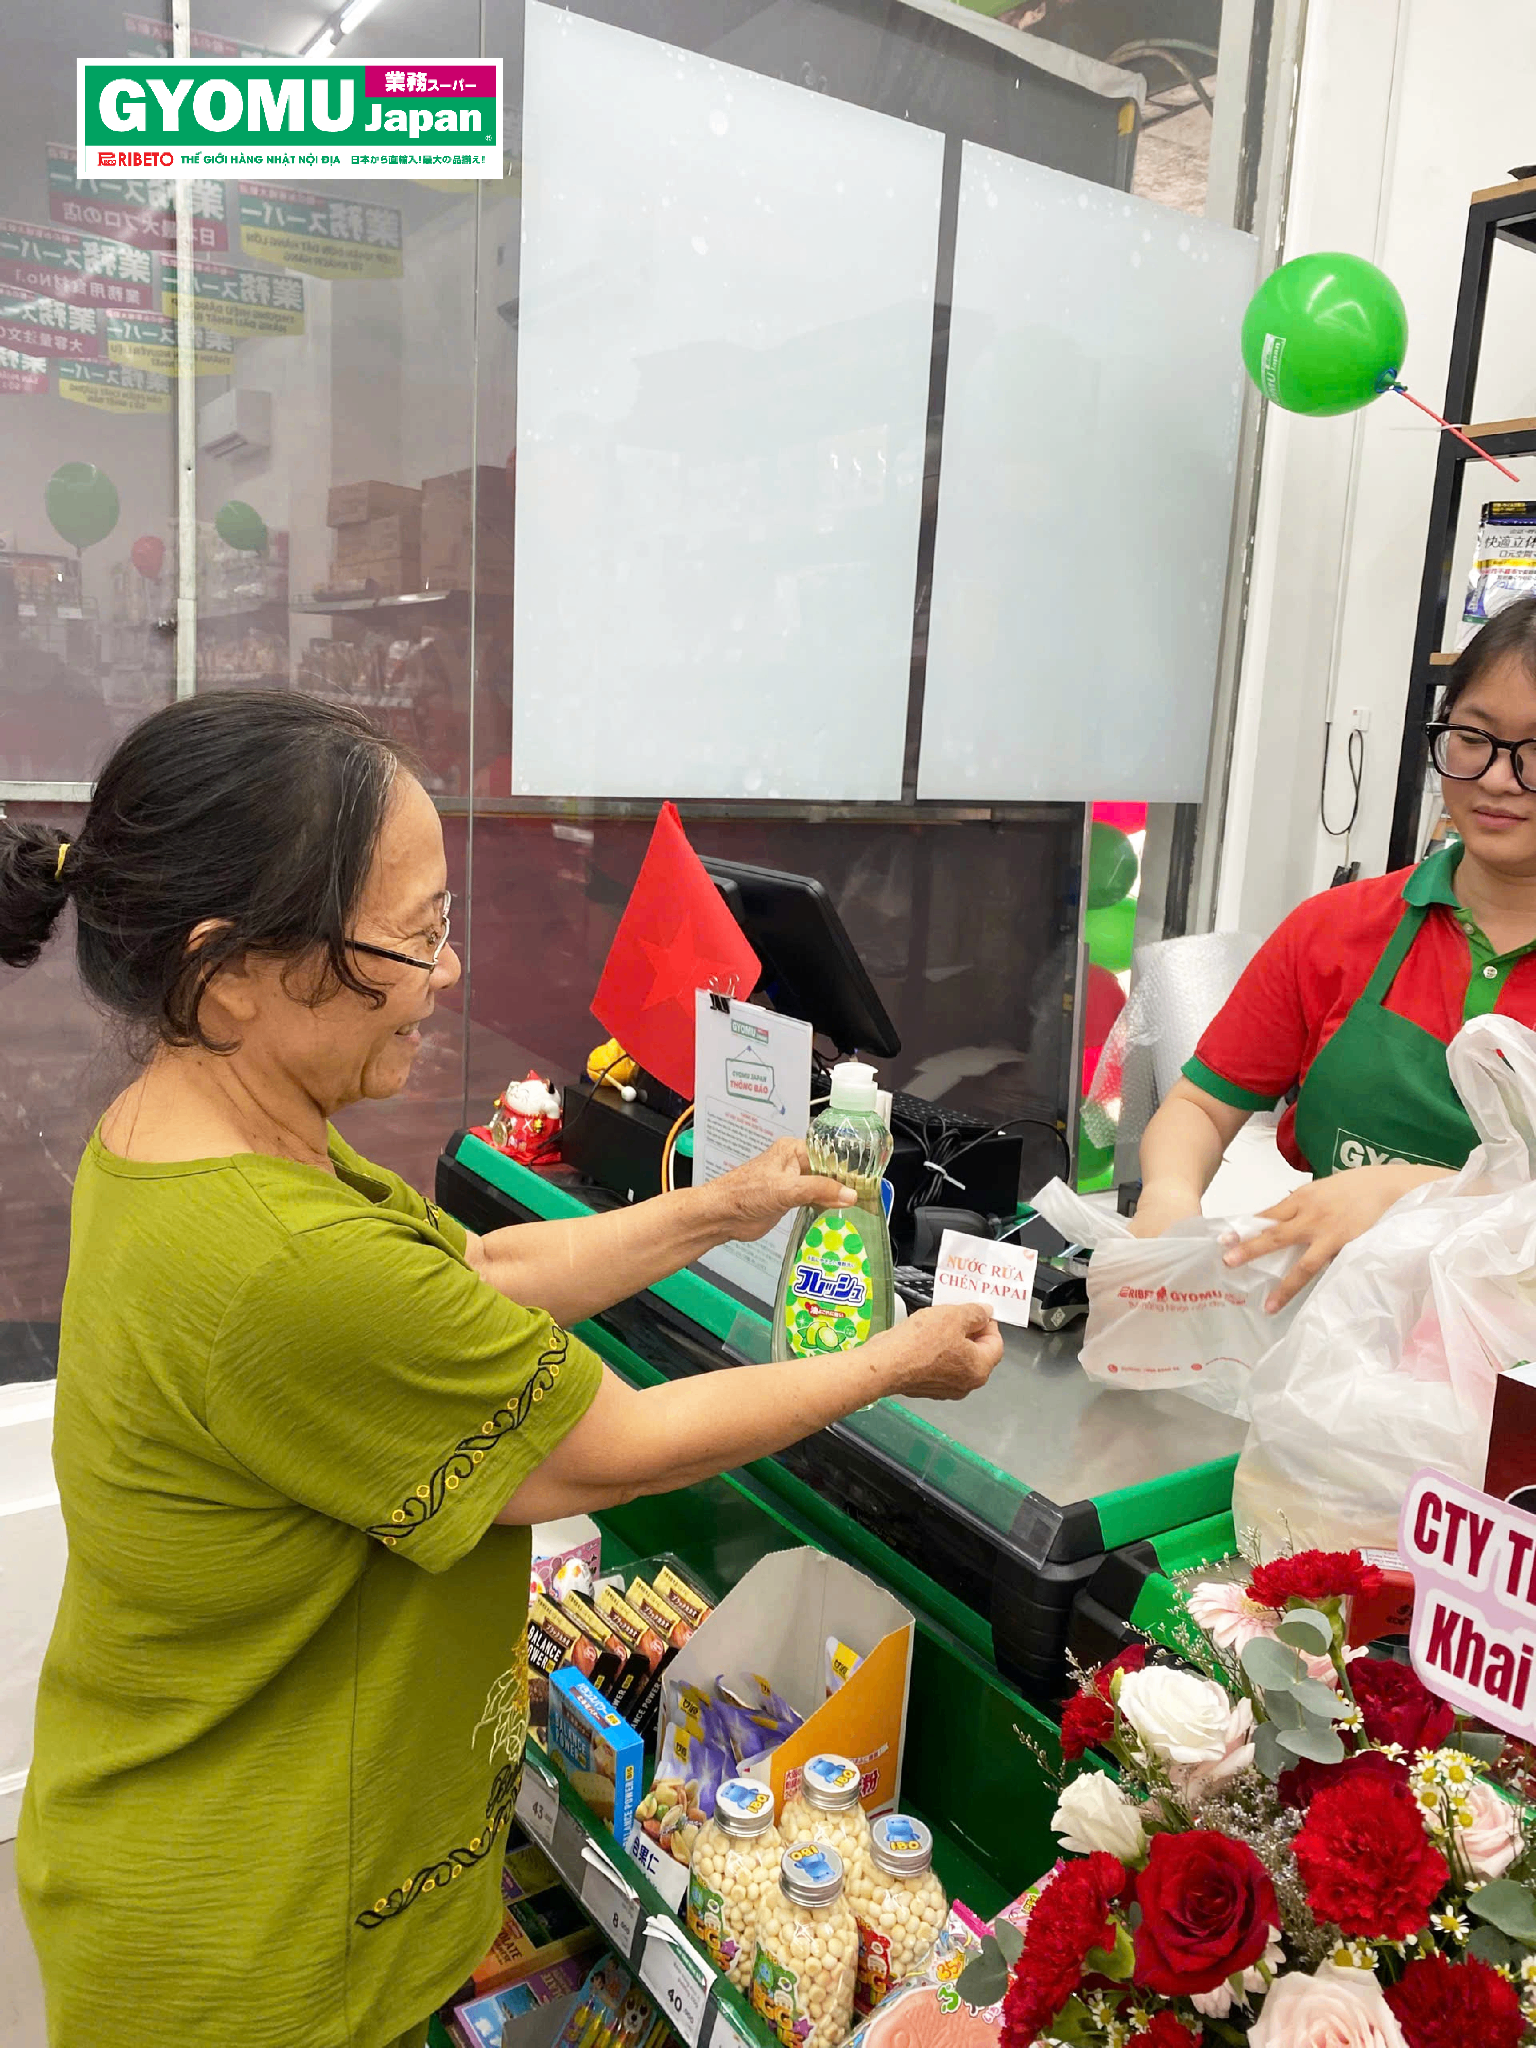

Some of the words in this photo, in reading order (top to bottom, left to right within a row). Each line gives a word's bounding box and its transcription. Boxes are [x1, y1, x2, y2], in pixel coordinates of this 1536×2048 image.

[729, 1079, 753, 1092] THÔNG
[753, 1083, 769, 1095] BÁO
[1340, 1140, 1411, 1169] GY
[947, 1254, 987, 1275] NƯỚC
[939, 1273, 978, 1292] CHÉN
[981, 1281, 1027, 1301] PAPAI
[1413, 1490, 1496, 1579] CTY
[527, 1624, 562, 1663] BALANCE
[1425, 1602, 1535, 1712] Khai
[832, 1768, 857, 1789] IBO
[625, 1779, 635, 1812] POWER
[745, 1793, 770, 1815] IBO
[532, 1801, 544, 1820] 43
[890, 1840, 920, 1851] IBO
[612, 1912, 619, 1929] 8
[667, 1988, 683, 2013] 40
